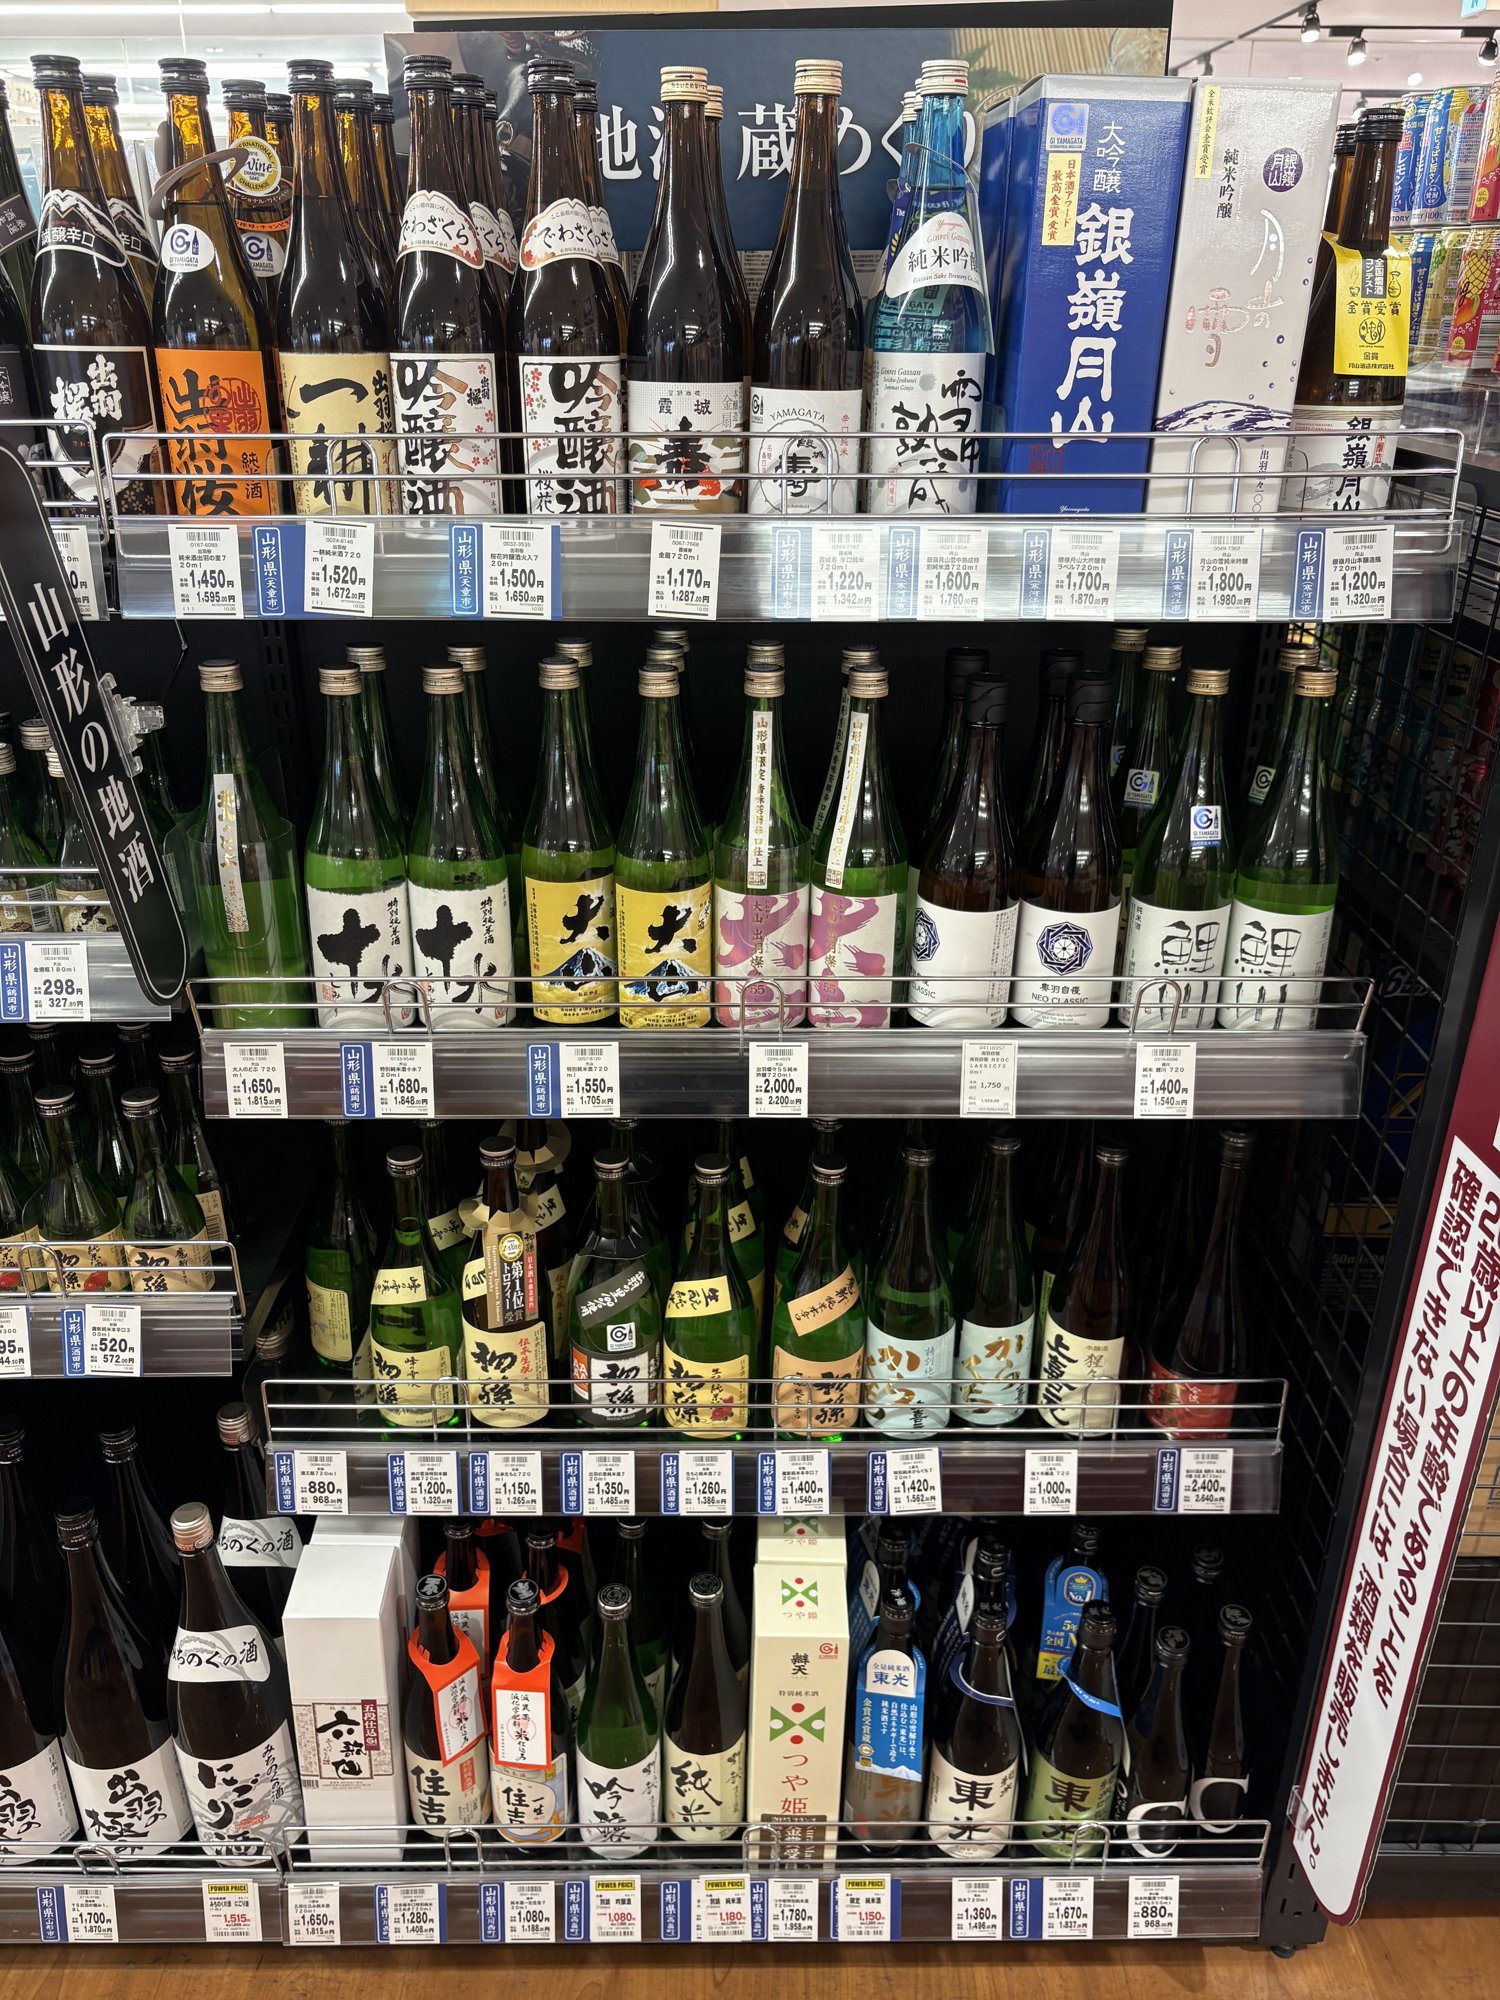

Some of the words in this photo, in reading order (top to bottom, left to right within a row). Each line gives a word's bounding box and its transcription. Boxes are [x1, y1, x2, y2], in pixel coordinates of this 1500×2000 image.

[1092, 121, 1125, 194] 大吟醸
[1064, 159, 1077, 228] 日本酒アワード
[1216, 149, 1239, 219] 純米吟醸
[1046, 169, 1063, 241] 最高金賞受賞
[400, 216, 469, 246] でわざくら
[1365, 258, 1374, 296] コンテスト
[1346, 301, 1402, 316] 金賞受賞
[1050, 202, 1134, 445] 銀嶺月山
[1363, 352, 1379, 361] 金賞
[769, 407, 826, 423] YAMAGATA
[189, 569, 234, 588] 1,450円
[261, 533, 279, 611] 山形県(天童市)
[322, 564, 366, 585] 1,520円
[457, 531, 473, 609] 山形県(天童市)
[500, 568, 544, 588] 1,500円
[667, 568, 710, 588] 1,170円
[1171, 537, 1188, 614] 山形県(寒河江市)
[1300, 536, 1318, 614] 山形県(寒河江市)
[1341, 570, 1385, 591] 1,200円
[1066, 571, 1110, 591] 1,700円
[1208, 573, 1252, 592] 1,800円
[28, 583, 155, 903] 山形の地酒
[3, 948, 19, 1015] 山形県(鶴岡市)
[43, 978, 83, 995] 298円
[1031, 992, 1049, 1004] NEO
[241, 1078, 281, 1094] 1,650円
[347, 1049, 361, 1112] 山形県(鶴岡市)
[388, 1078, 428, 1094] 1,680円
[575, 1078, 613, 1094] 1,550円
[763, 1078, 802, 1094] 2,000円
[1150, 1079, 1188, 1094] 1,400円
[502, 1262, 513, 1309] トロフィー
[511, 1260, 525, 1309] 第1位
[68, 1313, 82, 1372] 山形県(酒田市)
[99, 1338, 134, 1353] 520円
[1373, 1191, 1500, 1709] 2歳以上の年齢であることを
[308, 1481, 342, 1494] 880円
[784, 1537, 818, 1546] つや姫
[783, 1611, 818, 1620] つや姫
[1044, 1636, 1064, 1646] 全国
[873, 1662, 910, 1672] 全量純米酒
[872, 1671, 910, 1687] 東光
[363, 1703, 377, 1738] 五段仕込
[780, 1752, 809, 1815] つや姫
[411, 1764, 451, 1825] 住吉
[670, 1759, 723, 1832] 純米
[502, 1785, 531, 1826] 住吉
